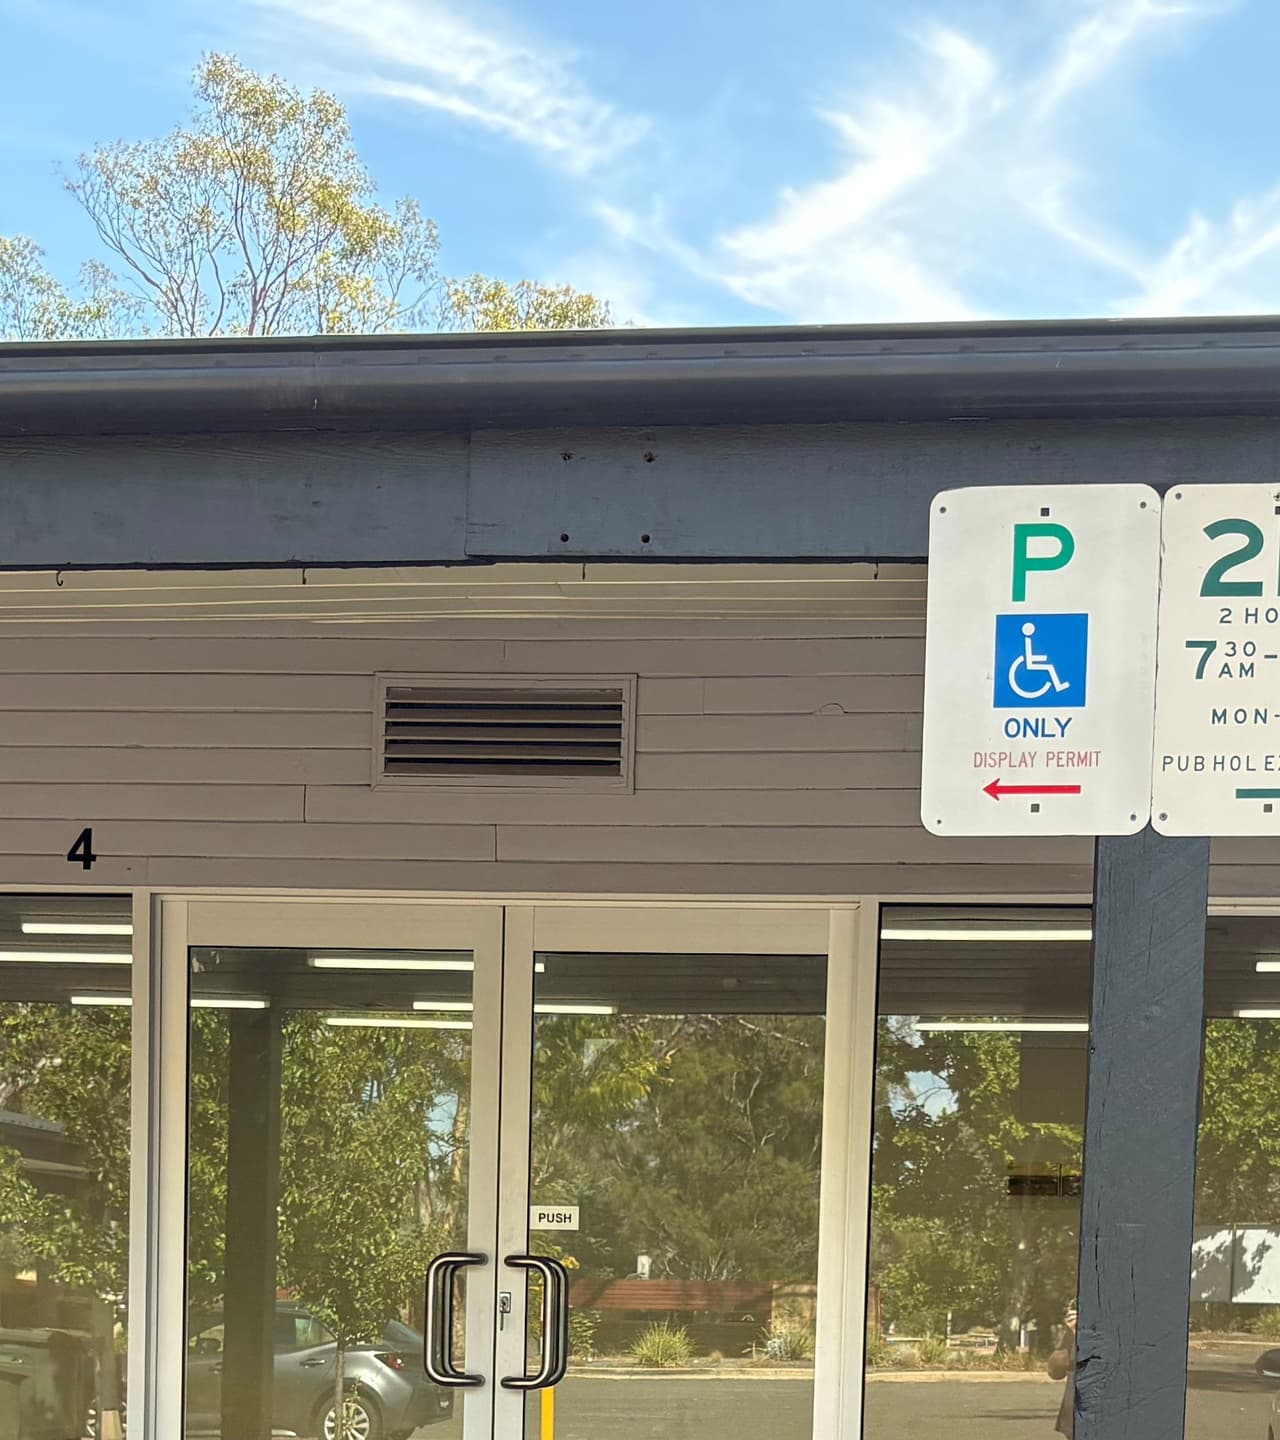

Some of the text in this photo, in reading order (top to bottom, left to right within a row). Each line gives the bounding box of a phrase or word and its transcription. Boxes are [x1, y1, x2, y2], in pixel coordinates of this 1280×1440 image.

[1011, 522, 1076, 603] P
[1219, 607, 1233, 624] 2
[1218, 662, 1255, 679] AM
[1003, 716, 1073, 739] ONLY
[973, 750, 1102, 769] DISPLAY PERMIT
[1161, 755, 1206, 772] PUB
[1213, 755, 1257, 772] HOL
[67, 827, 97, 871] 4
[538, 1212, 573, 1224] PUSH
